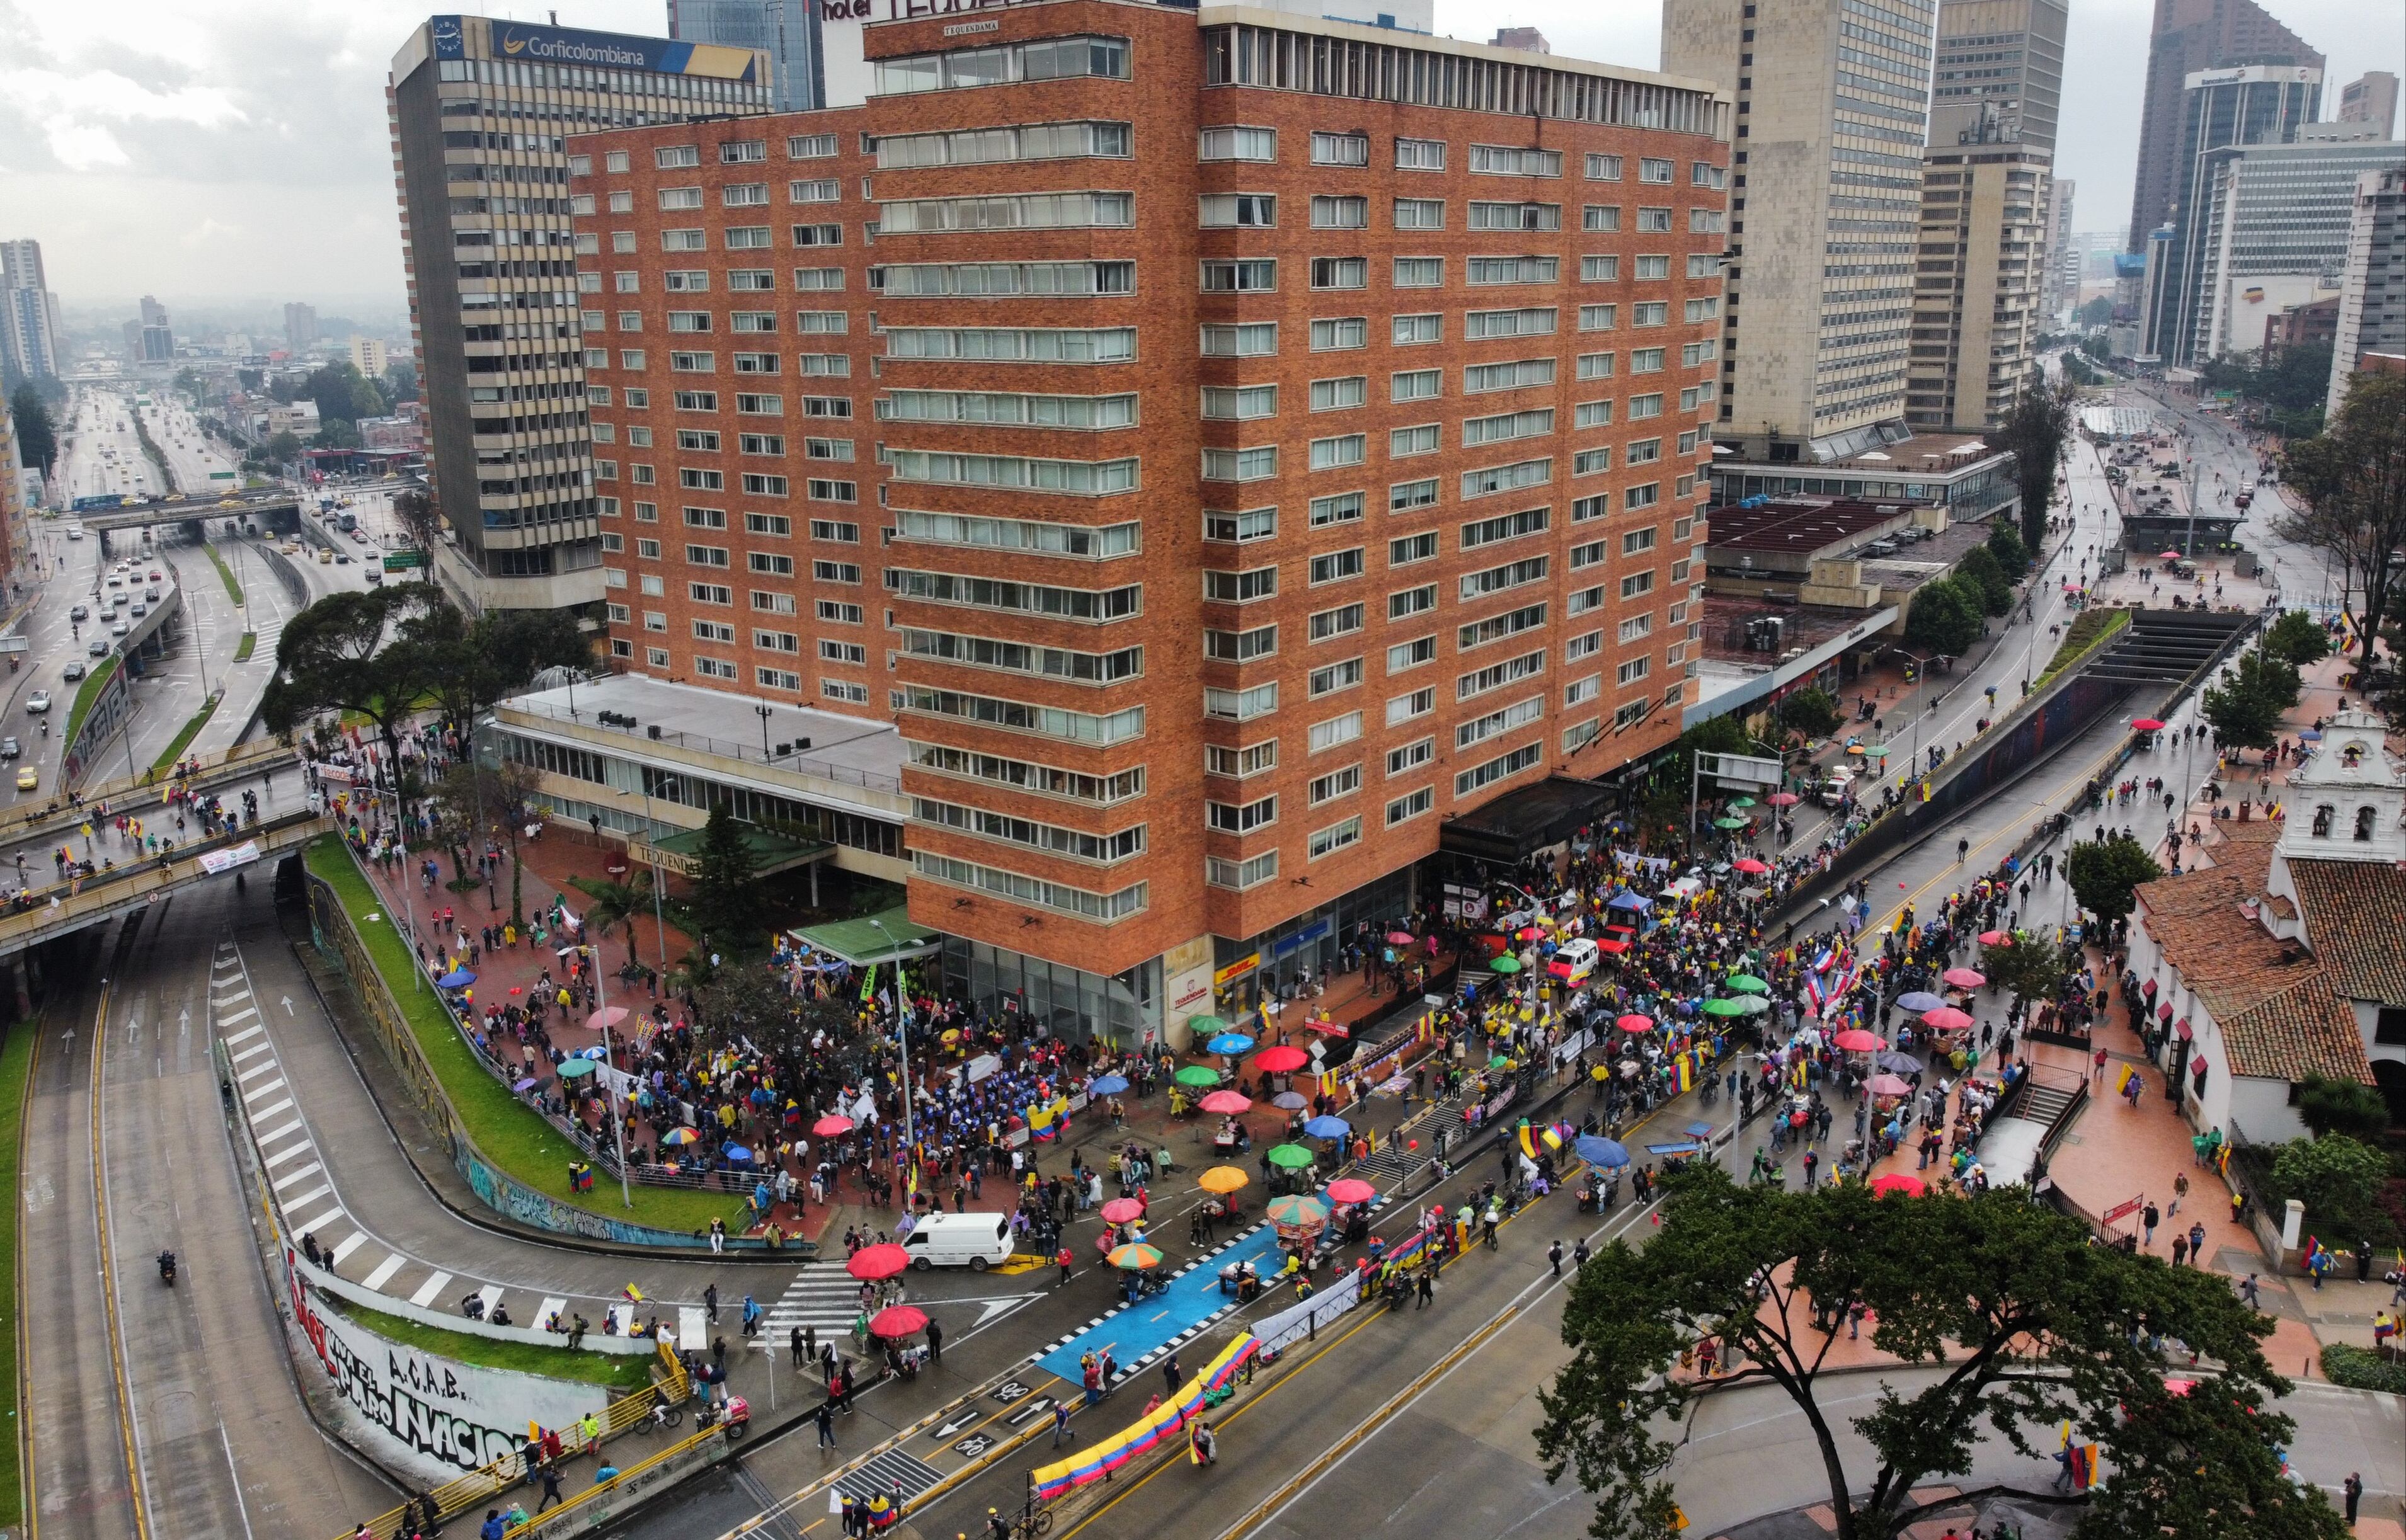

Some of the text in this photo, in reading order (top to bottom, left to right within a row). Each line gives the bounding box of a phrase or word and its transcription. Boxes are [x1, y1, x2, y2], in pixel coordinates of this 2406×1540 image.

[528, 36, 644, 66] Corficolombiana
[945, 23, 997, 35] TEQUENDAMA
[326, 1328, 377, 1389] VIVA EL
[336, 1357, 393, 1426] PARO
